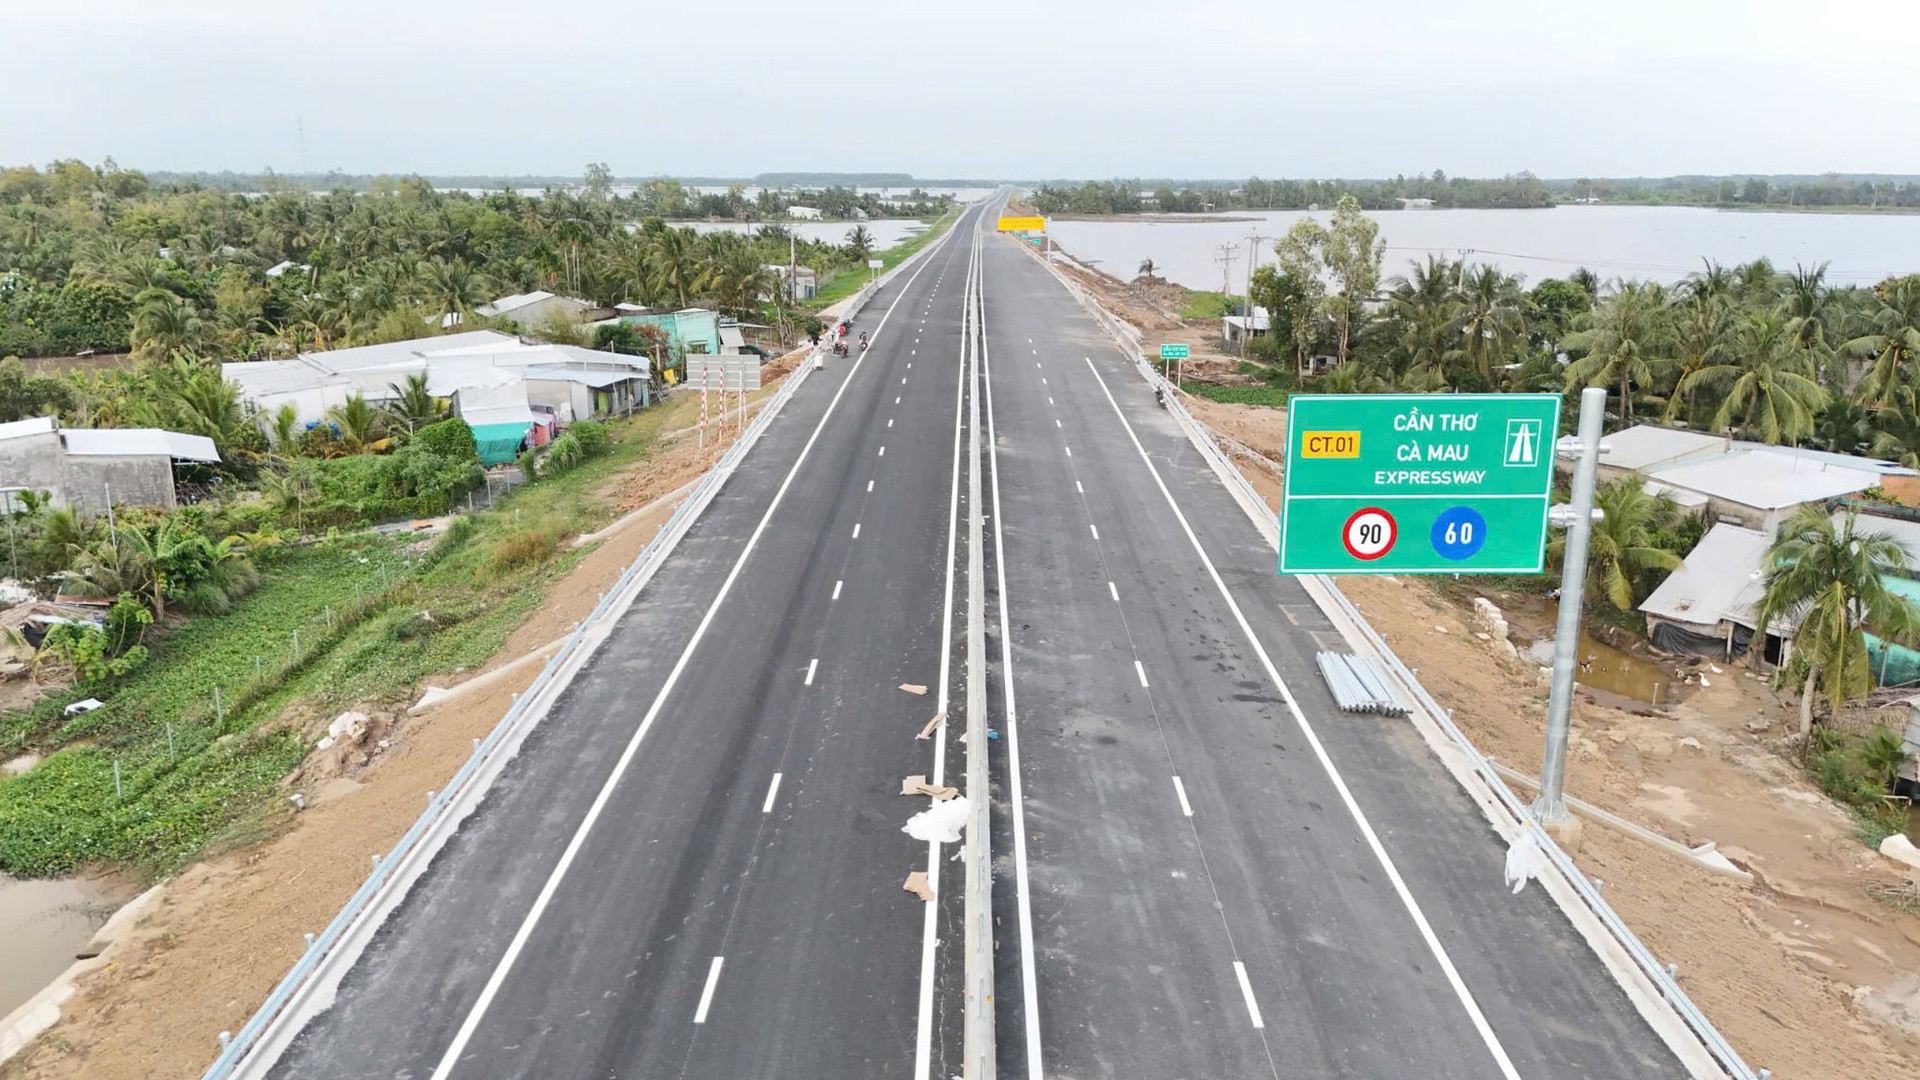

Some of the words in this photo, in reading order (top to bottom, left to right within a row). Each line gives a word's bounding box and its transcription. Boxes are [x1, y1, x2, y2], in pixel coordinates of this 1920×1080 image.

[1394, 407, 1433, 431] CẦN
[1439, 413, 1479, 431] THƠ
[1309, 437, 1354, 453] CT.01
[1397, 442, 1422, 461] CÀ
[1427, 445, 1469, 461] MAU
[1374, 471, 1486, 485] EXPRESSWAY
[1359, 524, 1382, 544] 90
[1444, 522, 1473, 545] 60
